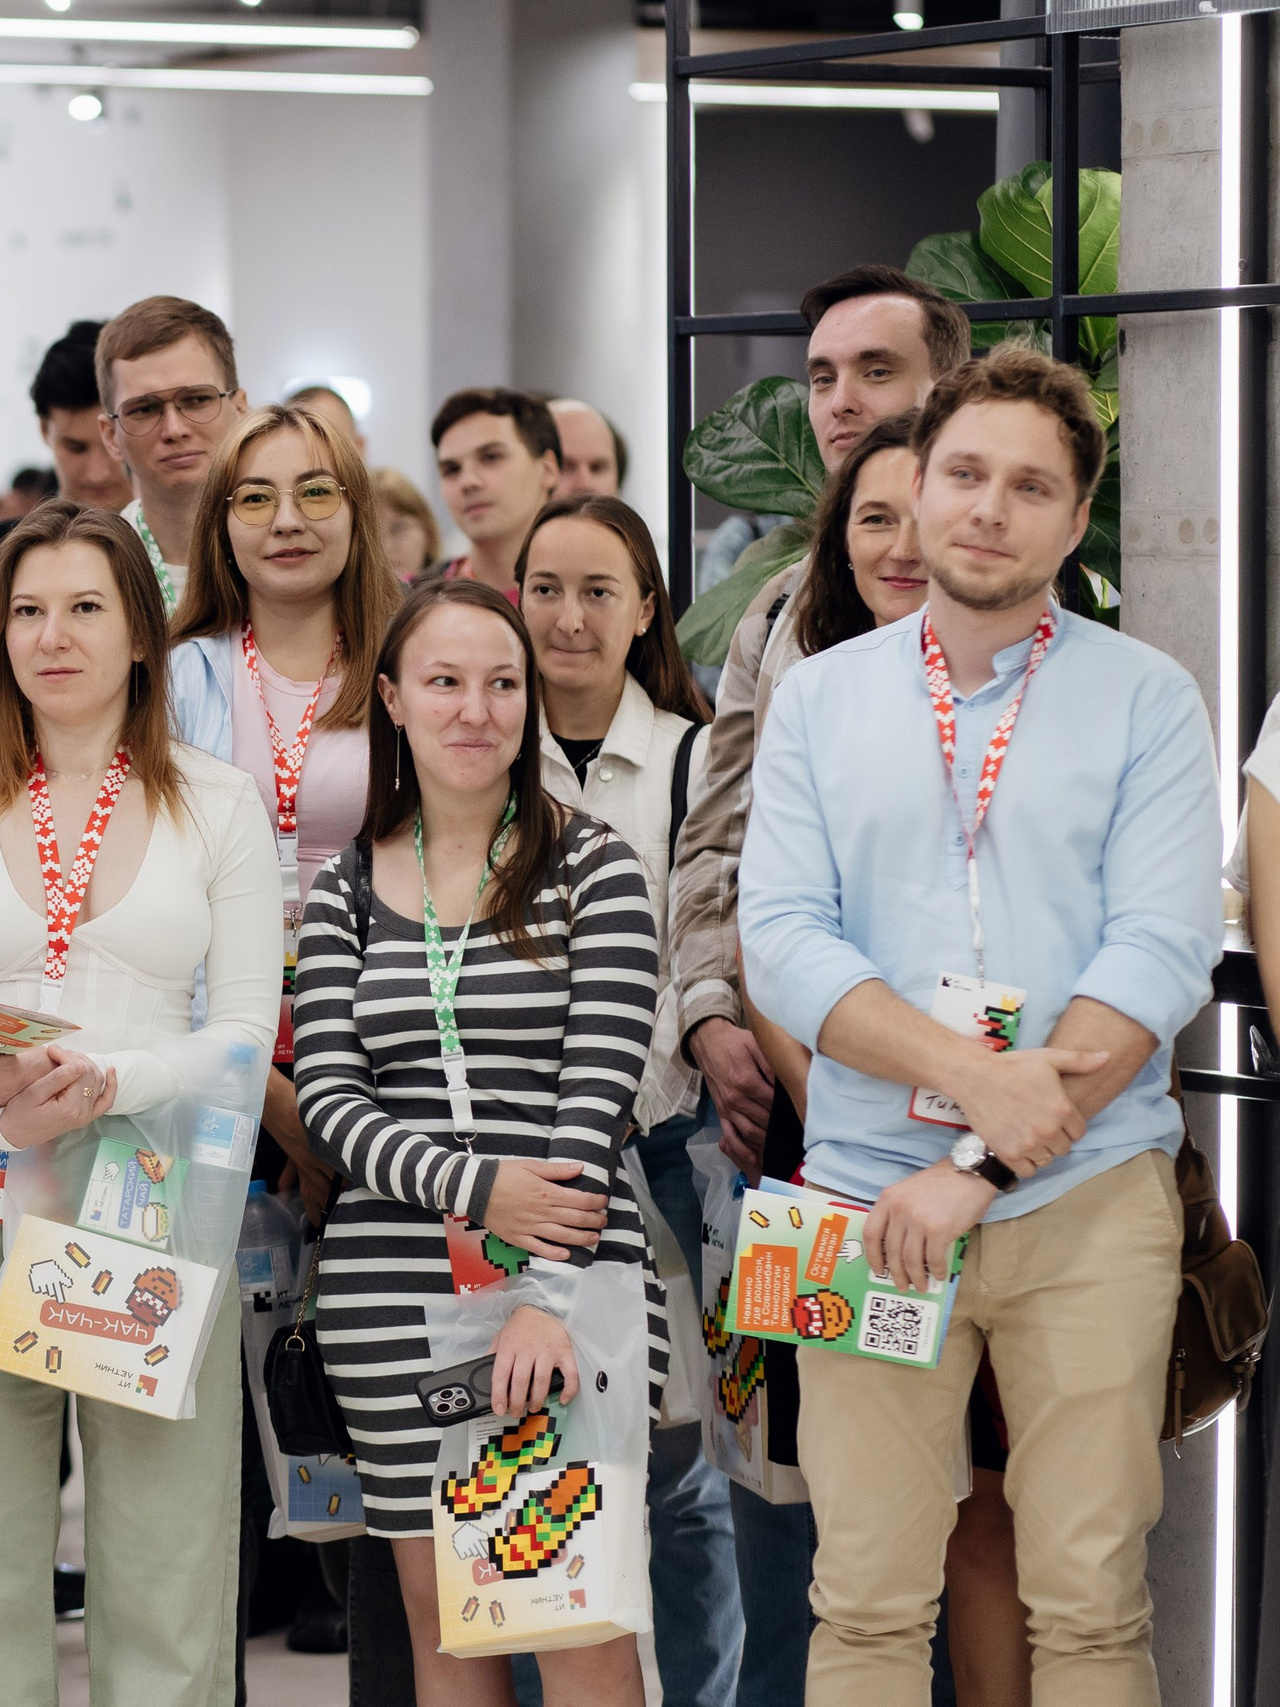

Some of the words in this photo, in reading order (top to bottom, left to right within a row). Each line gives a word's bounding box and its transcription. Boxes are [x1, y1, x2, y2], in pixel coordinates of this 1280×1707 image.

[120, 1160, 138, 1226] ТАТАРСКИЙ
[138, 1183, 149, 1206] ЧАЙ
[761, 1251, 773, 1315] Совкомбанк
[819, 1266, 829, 1279] на
[770, 1265, 781, 1326] Технологии
[781, 1266, 791, 1327] пригодился
[46, 1305, 150, 1341] ЧАК-ЧАК
[753, 1306, 761, 1325] где
[762, 1318, 770, 1326] в
[94, 1362, 134, 1379] ЛЕТНИК
[117, 1380, 131, 1389] ИТ
[530, 1593, 564, 1605] ЛЕТНИК
